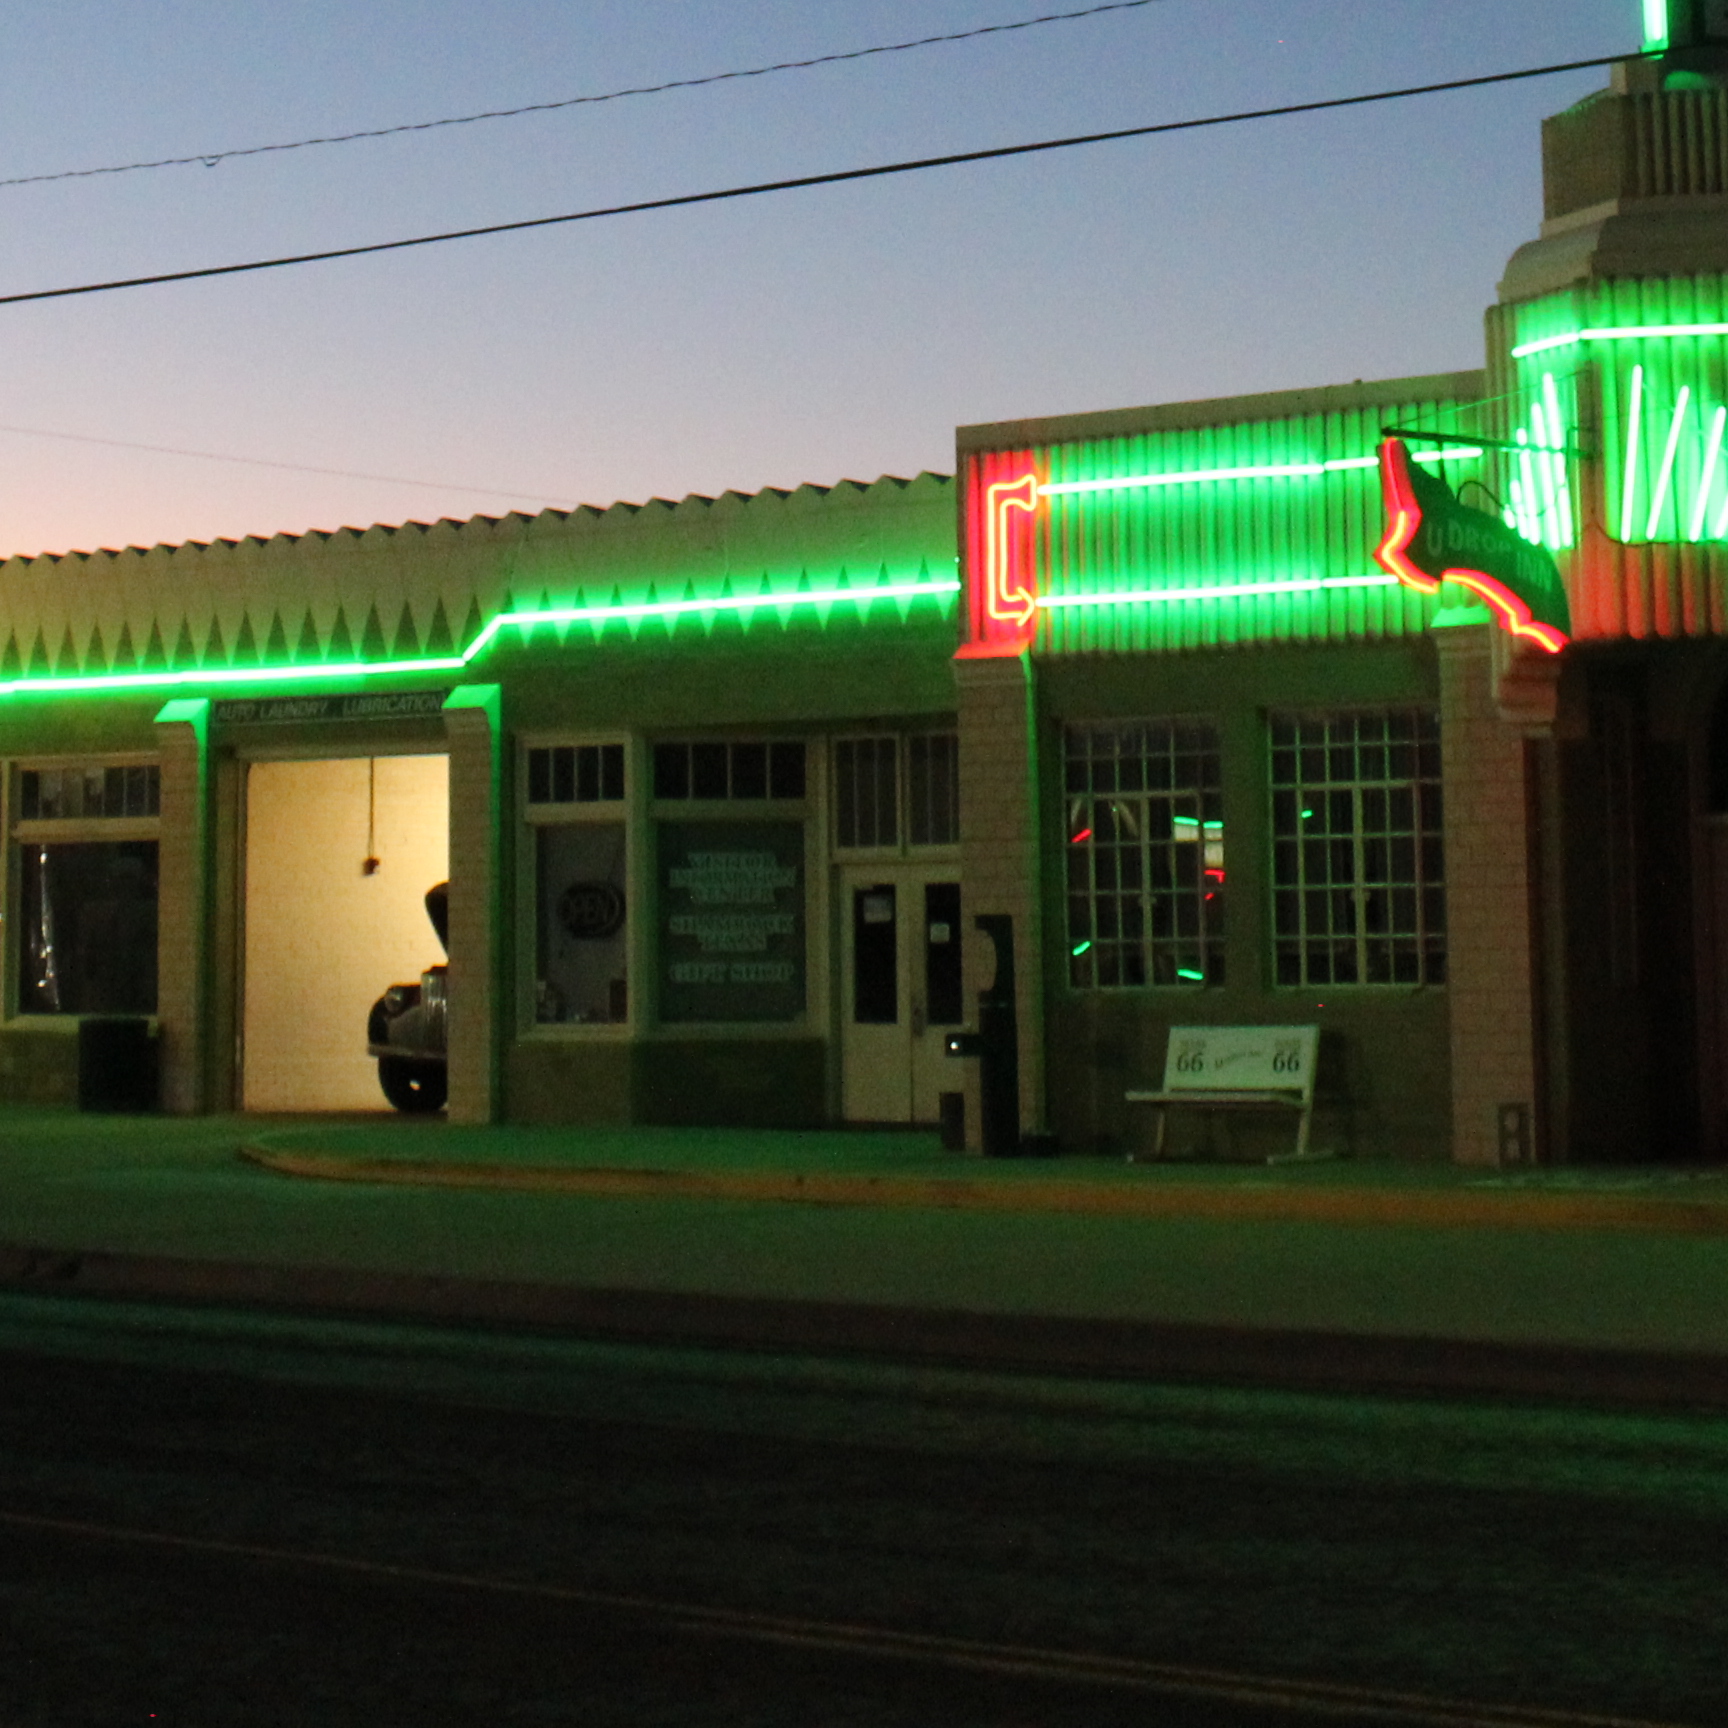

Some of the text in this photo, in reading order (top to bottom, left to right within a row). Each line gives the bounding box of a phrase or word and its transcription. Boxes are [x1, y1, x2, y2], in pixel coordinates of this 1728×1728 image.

[1426, 520, 1443, 557] U
[218, 695, 443, 722] AUTO LAUNDRY LUBRICATION
[556, 892, 609, 926] OPEN
[1176, 1051, 1204, 1073] 66
[1272, 1051, 1301, 1073] 66
